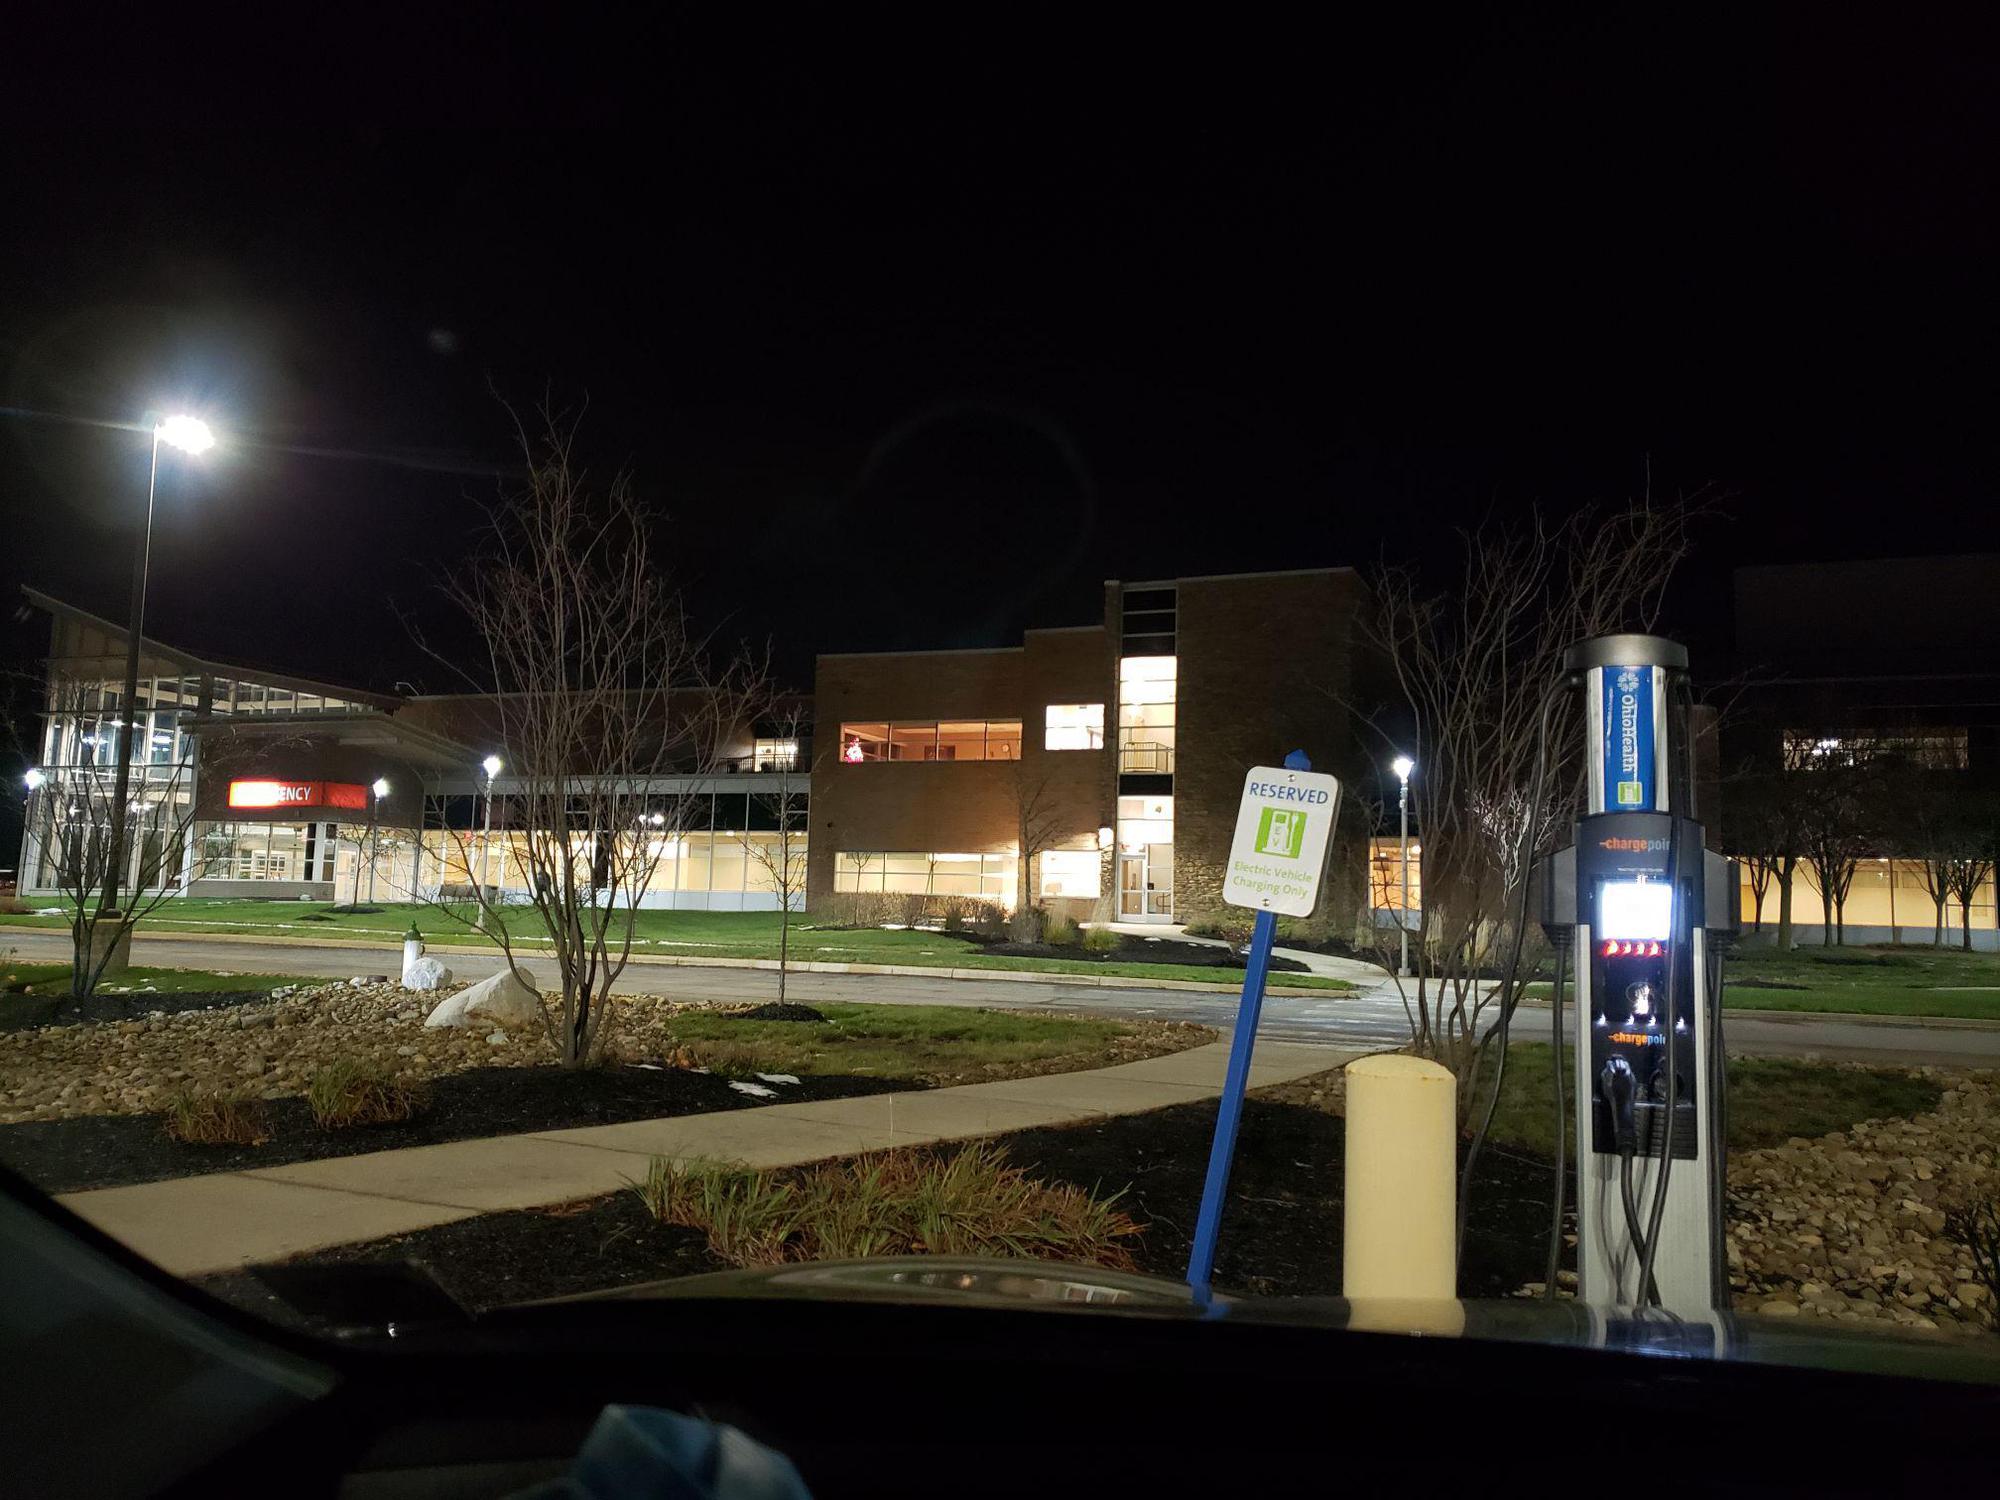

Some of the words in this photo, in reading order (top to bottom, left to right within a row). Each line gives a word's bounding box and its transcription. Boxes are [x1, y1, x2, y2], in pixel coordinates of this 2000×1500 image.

[1250, 782, 1328, 804] RESERVED
[1233, 861, 1272, 876] Electric
[1274, 868, 1312, 882] Vehicle
[1233, 875, 1281, 895] Charging
[1282, 883, 1308, 898] Only
